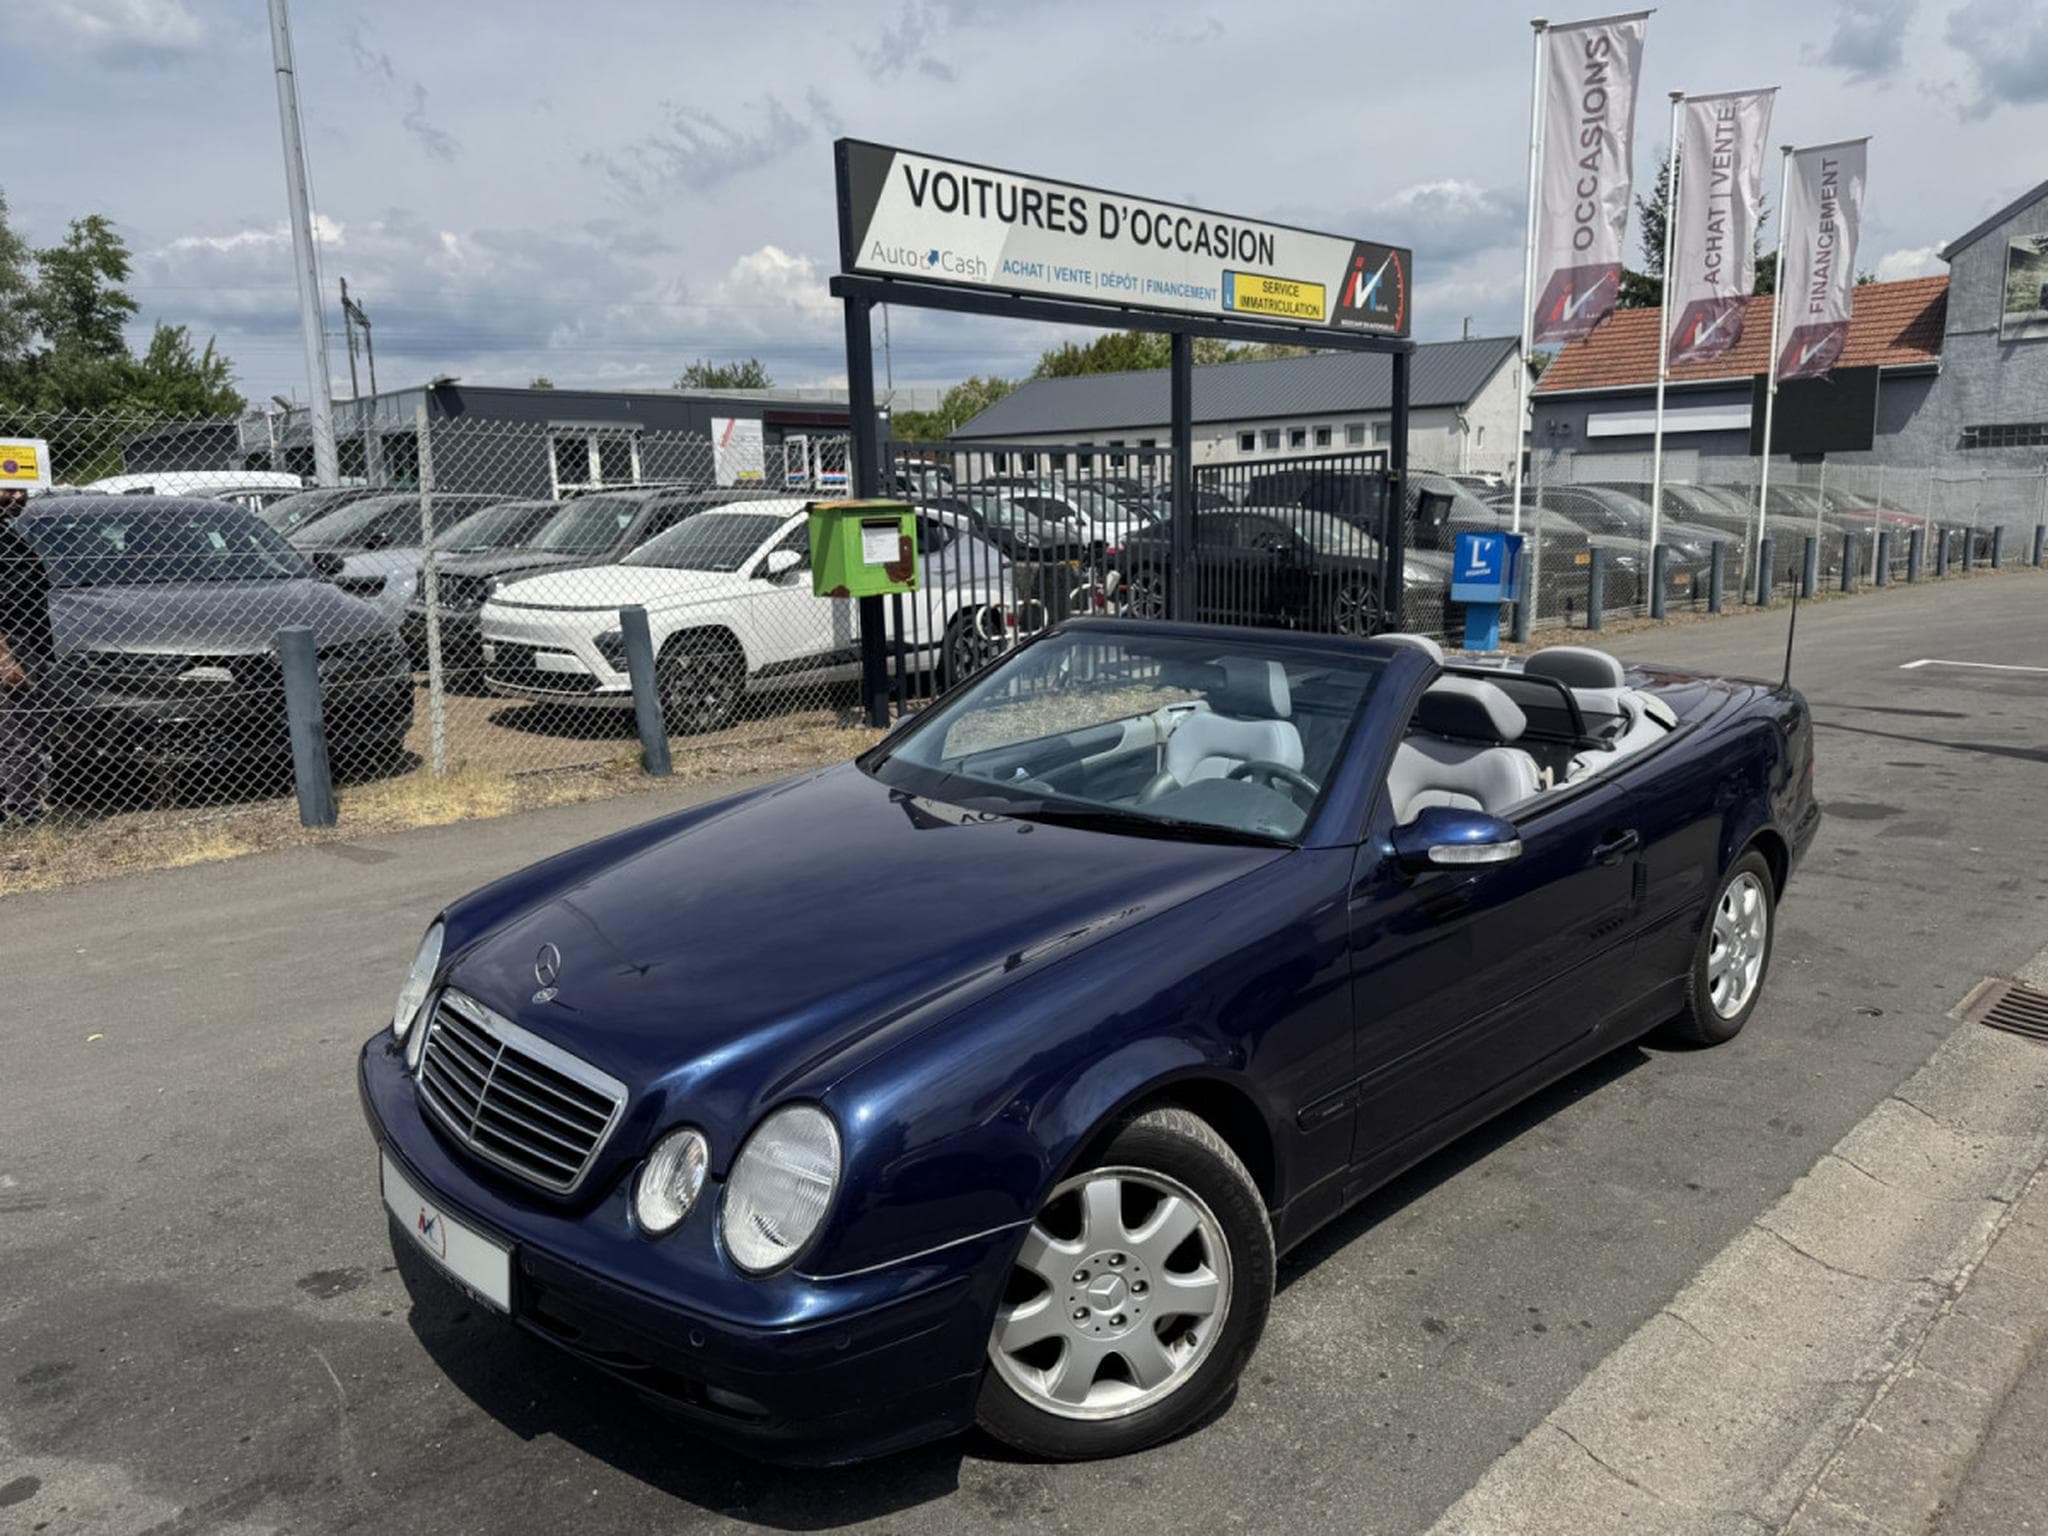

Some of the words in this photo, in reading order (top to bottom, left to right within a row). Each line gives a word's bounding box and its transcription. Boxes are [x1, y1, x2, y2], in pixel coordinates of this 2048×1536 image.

[1572, 35, 1610, 251] OCCASIONS
[1711, 106, 1736, 188] VENTE
[903, 164, 1088, 235] VOITURES
[1100, 202, 1274, 266] D'OCCASION
[1704, 206, 1725, 285] ACHAT
[1809, 158, 1838, 314] FINANCEMENT
[870, 241, 918, 267] Auto
[942, 251, 987, 276] Cash
[1003, 259, 1044, 278] ACHAT
[1053, 267, 1092, 285] VENTE
[1101, 271, 1137, 291] DÉPÔT
[1146, 279, 1218, 301] FINANCEMENT
[1262, 280, 1300, 298] SERVICE
[1239, 295, 1320, 317] IMMATRICULATION
